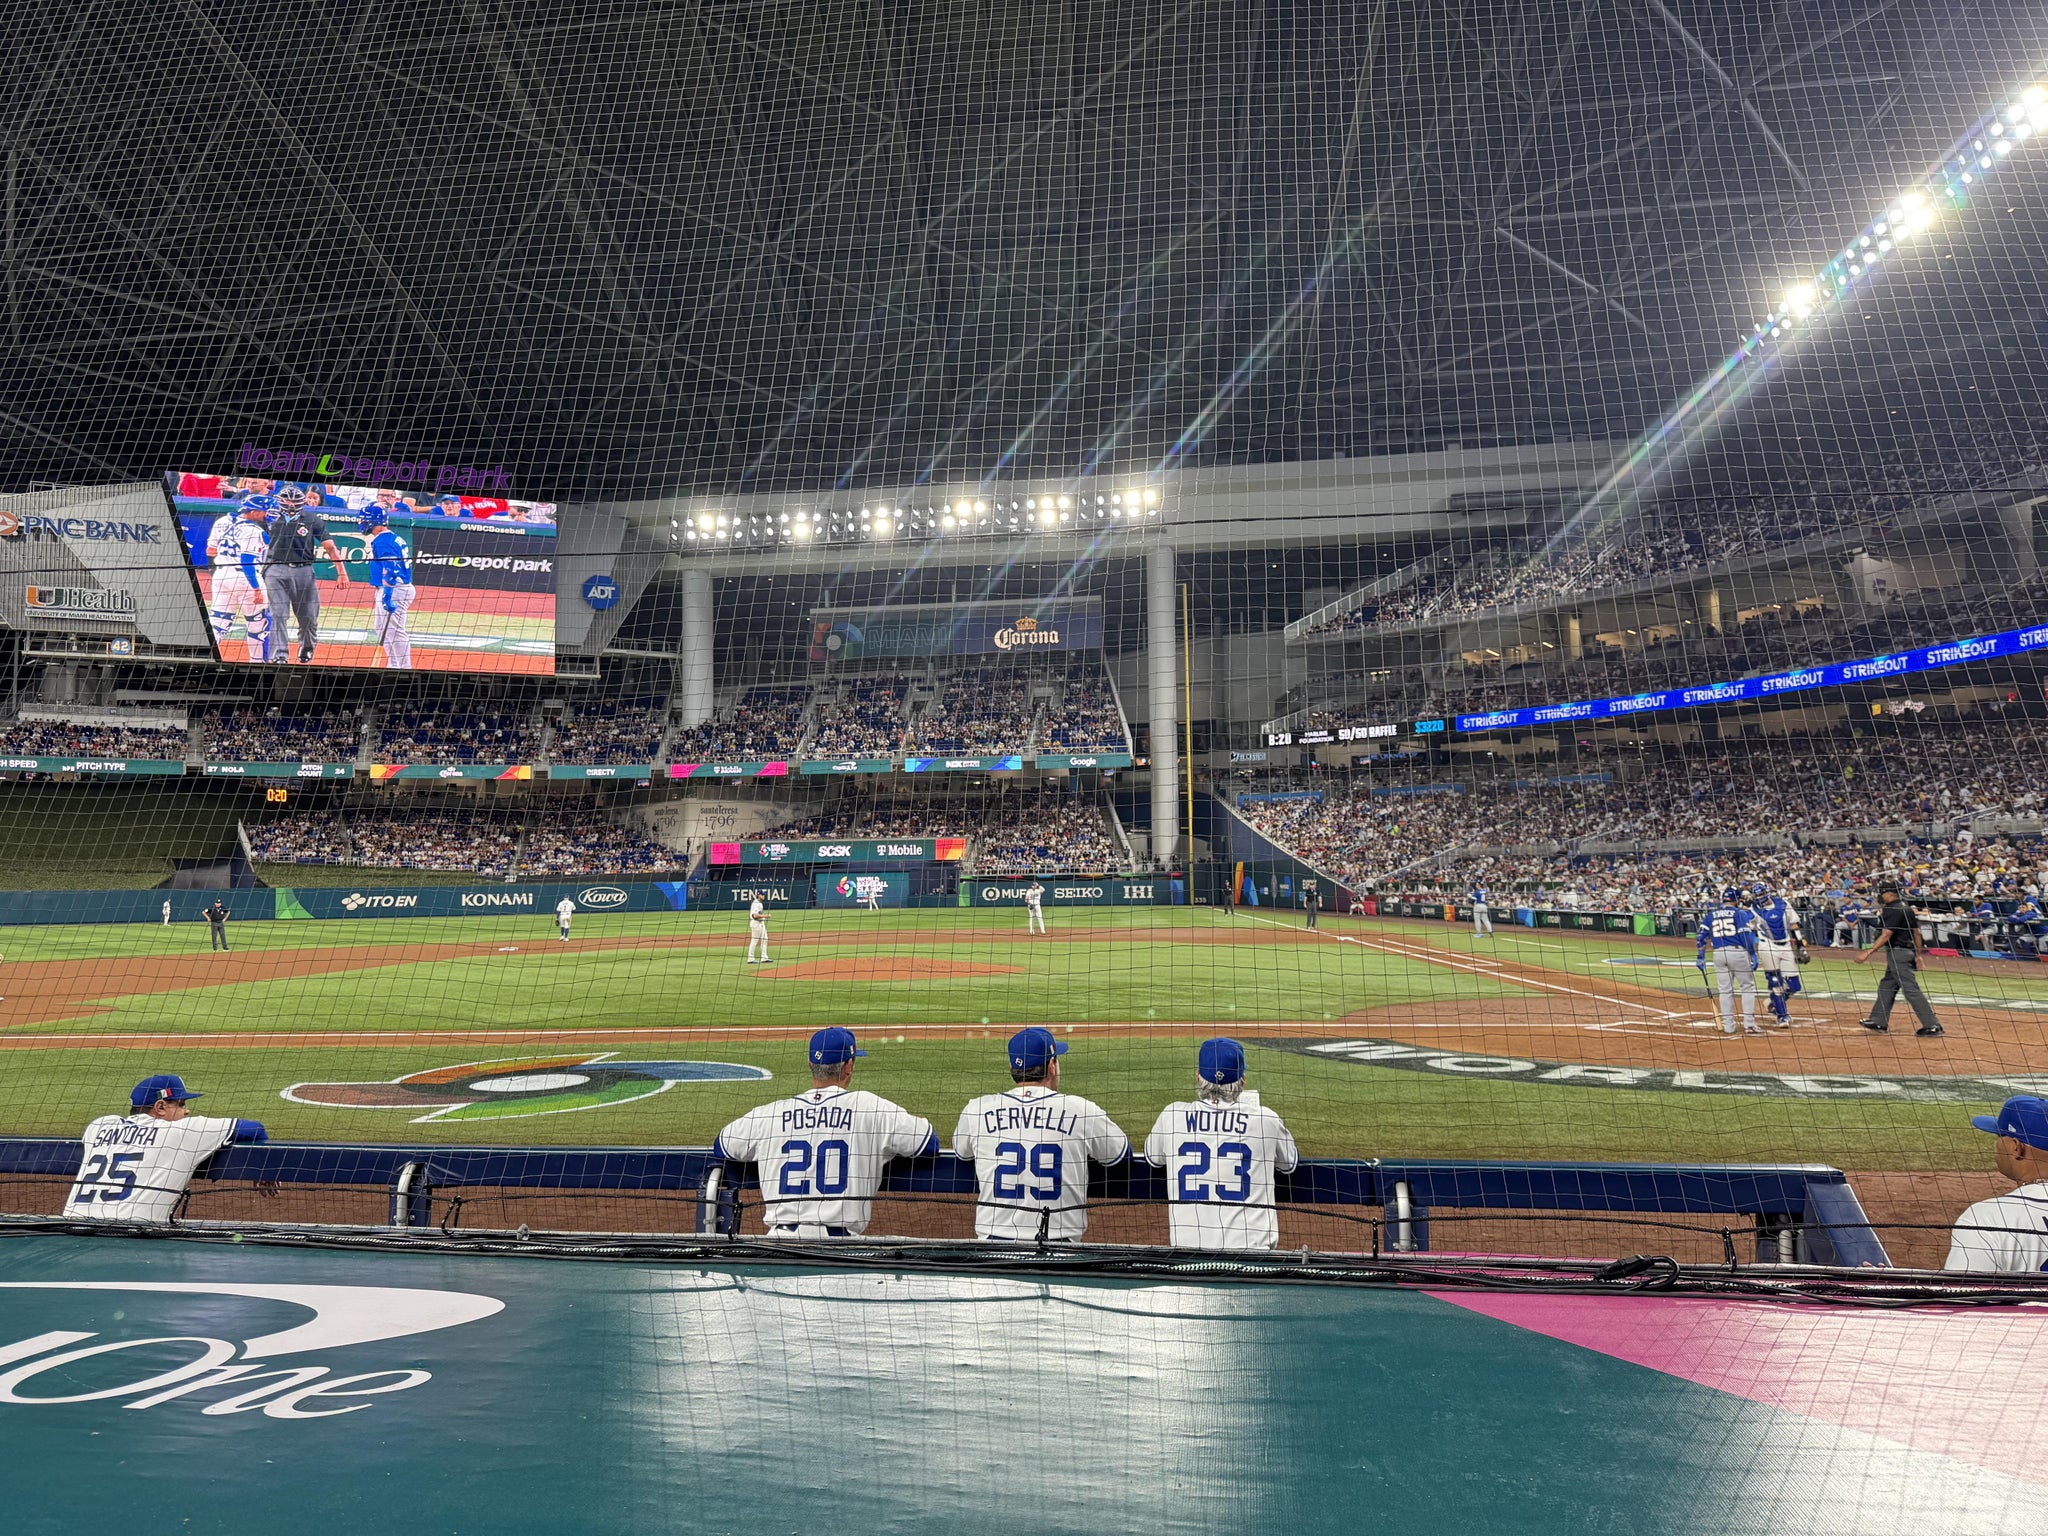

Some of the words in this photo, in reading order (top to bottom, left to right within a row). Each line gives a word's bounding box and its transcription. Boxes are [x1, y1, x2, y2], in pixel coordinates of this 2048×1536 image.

[239, 442, 430, 484] loanDepot
[435, 465, 512, 490] park
[415, 550, 510, 571] loanDepot
[512, 558, 553, 573] park
[588, 586, 615, 599] ADT
[26, 610, 60, 618] UNIVERSITY
[994, 627, 1060, 649] Corona
[111, 640, 130, 652] 42
[1463, 713, 1518, 728] STRIKEOUT
[1534, 705, 1591, 720] STRIKEOUT
[1609, 695, 1666, 712] STRIKEOUT
[1683, 686, 1745, 702] STRIKEOUT
[1761, 671, 1824, 692] STRIKEOUT
[1843, 657, 1908, 679] STRIKEOUT
[1927, 639, 1997, 665] STRIKEOUT
[1338, 727, 1367, 741] 50/50
[1368, 725, 1397, 738] RAFFLE
[9, 760, 38, 769] SPEED
[76, 762, 102, 770] PITCH
[104, 763, 126, 771] TYPE
[1070, 757, 1097, 767] Google
[586, 768, 616, 776] DIRECTV
[721, 766, 743, 774] Mobile
[267, 789, 287, 802] 0:20
[705, 815, 735, 830] 1796
[818, 846, 851, 857] SCSK
[888, 845, 923, 855] Mobile
[582, 890, 625, 903] Kowa
[1002, 889, 1027, 898] MUF
[1055, 887, 1103, 898] SEIKO
[1123, 885, 1154, 899] IHI
[366, 896, 391, 907] ITO
[398, 896, 417, 907] EN
[461, 893, 533, 907] KONAMI
[1712, 918, 1736, 938] 25
[1306, 1040, 1905, 1094] WORLD
[781, 1107, 852, 1132] POSADA
[984, 1110, 1077, 1137] CERVELLI
[1186, 1110, 1248, 1134] WOTUS
[779, 1139, 848, 1195] 20
[994, 1142, 1062, 1200] 29
[1178, 1142, 1252, 1200] 23
[74, 1152, 144, 1203] 25
[0, 1337, 432, 1418] One
